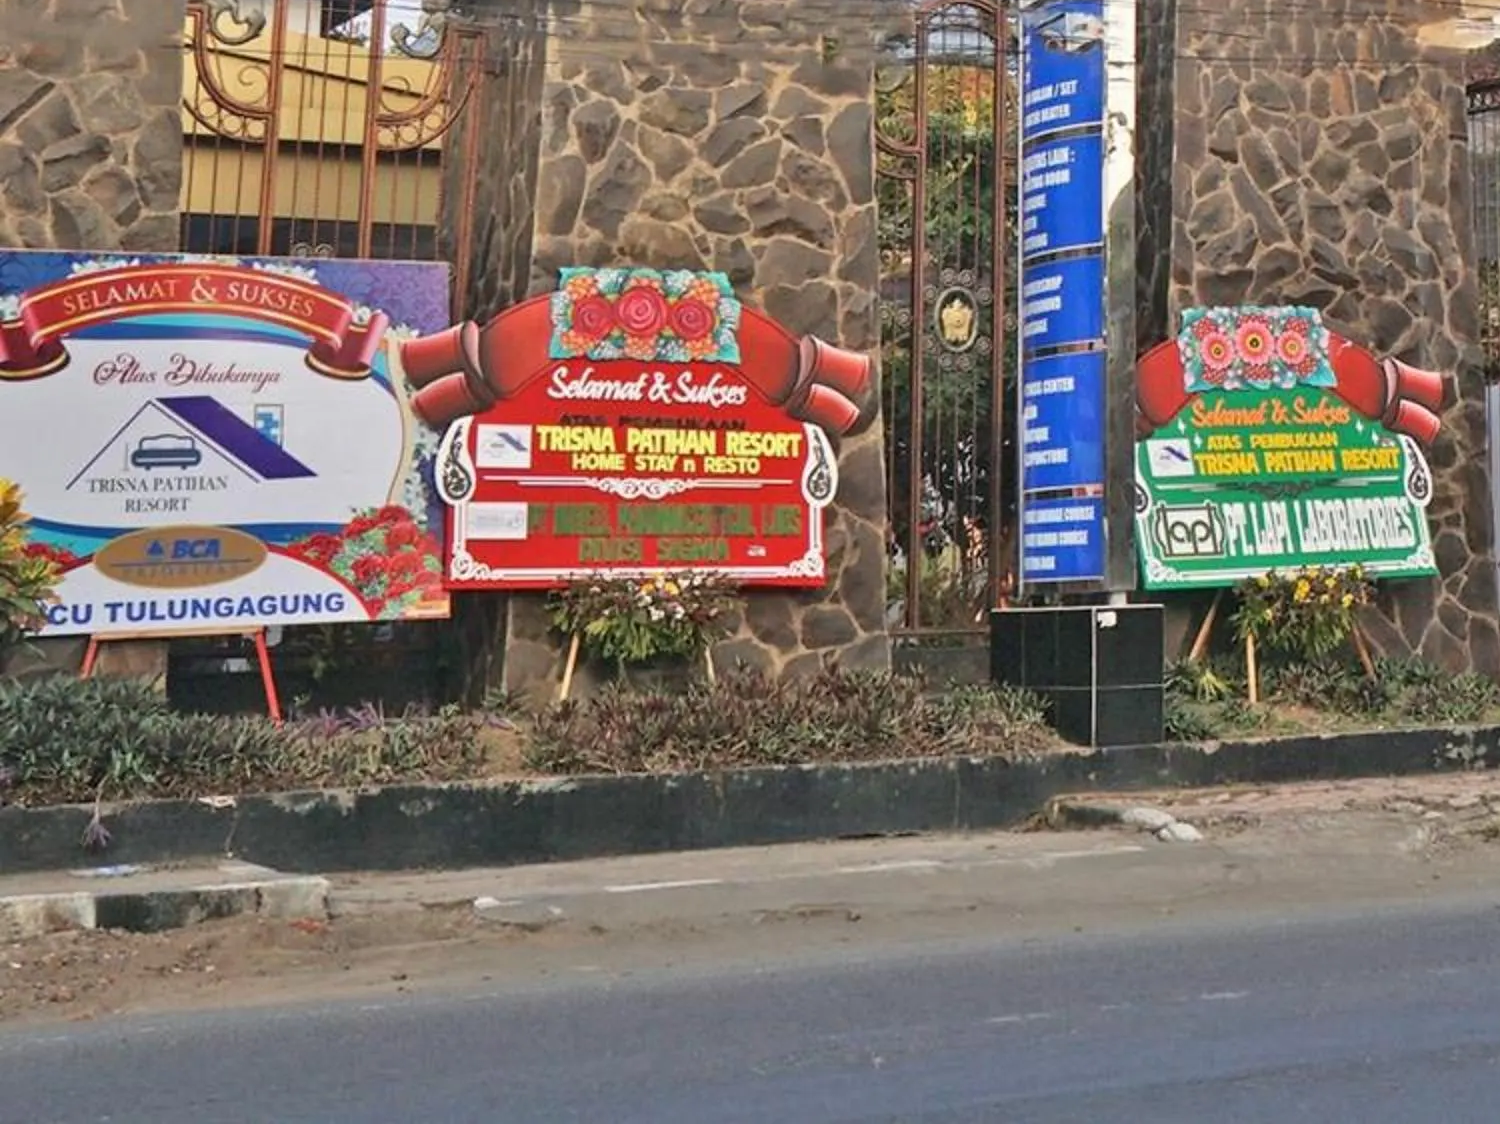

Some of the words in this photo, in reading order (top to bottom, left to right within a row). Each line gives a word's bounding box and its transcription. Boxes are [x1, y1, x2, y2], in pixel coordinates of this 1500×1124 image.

[63, 279, 180, 315] SELAMAT
[191, 275, 218, 304] &
[226, 281, 317, 317] SUKSES
[547, 366, 649, 401] Selamat
[648, 371, 672, 404] &
[672, 371, 747, 408] Sukses
[1191, 397, 1268, 428] Selamat
[1293, 396, 1350, 428] Sukses
[536, 426, 616, 453] TRISNA
[627, 427, 716, 456] PATIHAN
[726, 432, 802, 458] RESORT
[1207, 435, 1242, 451] ATAS
[572, 453, 625, 472] HOME
[635, 454, 678, 472] STAY
[683, 459, 696, 473] n
[703, 456, 761, 474] RESTO
[1194, 451, 1260, 476] TRISNA
[1264, 450, 1336, 473] PATIHAN
[1341, 447, 1400, 471] RESORT
[88, 477, 149, 493] TRISNA
[153, 476, 228, 491] PATIHAN
[125, 497, 190, 513] RESORT
[172, 538, 221, 558] BCA
[104, 592, 346, 623] TULUNGAGUNG
